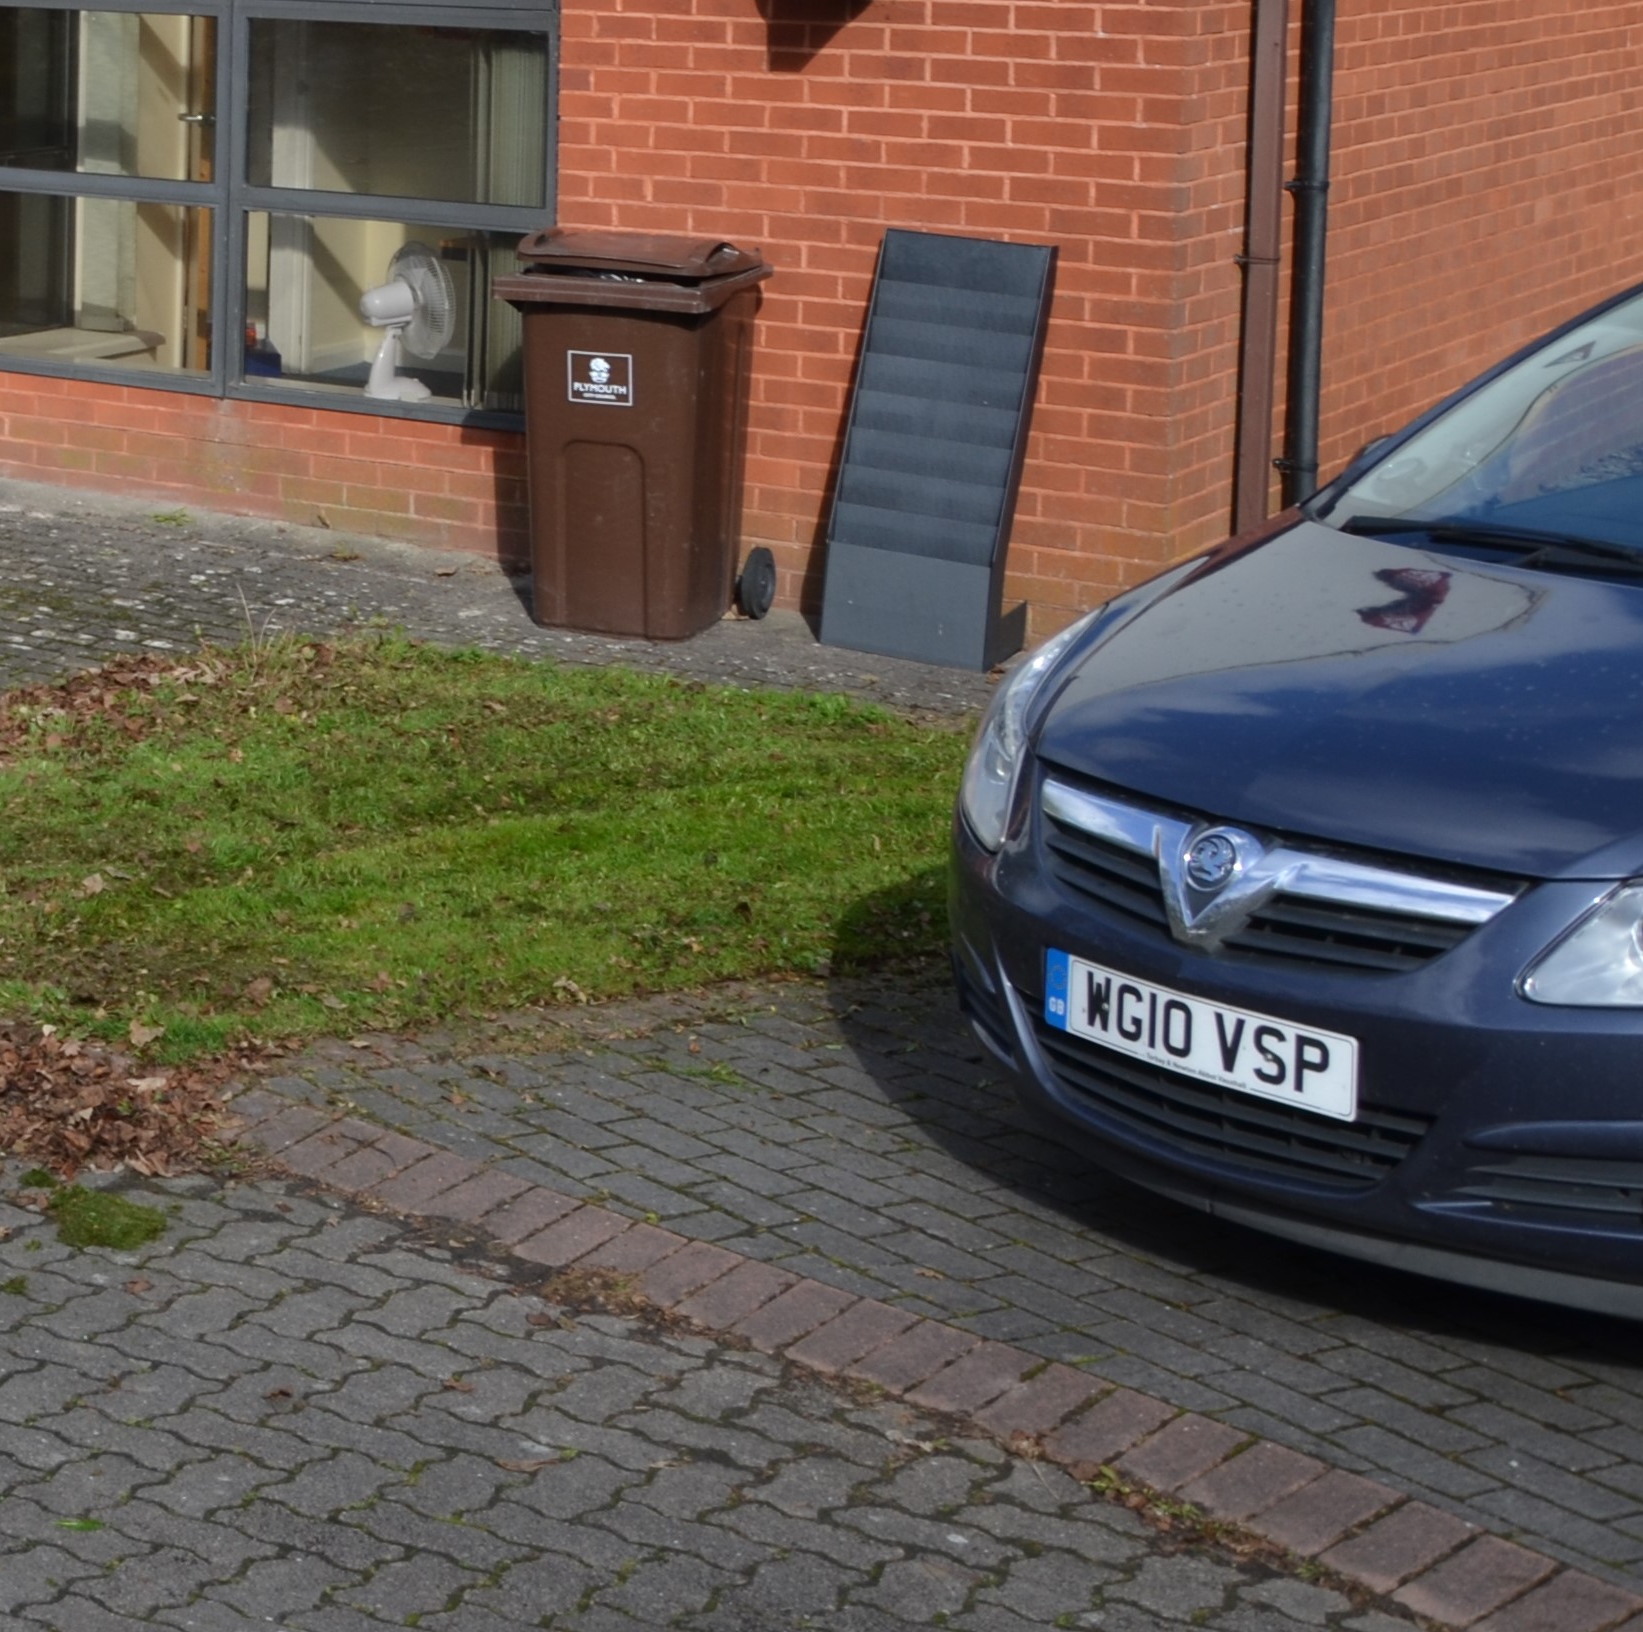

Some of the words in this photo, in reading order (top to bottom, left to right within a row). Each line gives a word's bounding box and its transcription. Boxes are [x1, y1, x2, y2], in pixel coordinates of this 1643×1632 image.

[573, 382, 626, 394] PLYMOUTH
[1048, 996, 1065, 1016] GB
[1086, 970, 1192, 1058] WG10
[1213, 1010, 1330, 1093] VSP
